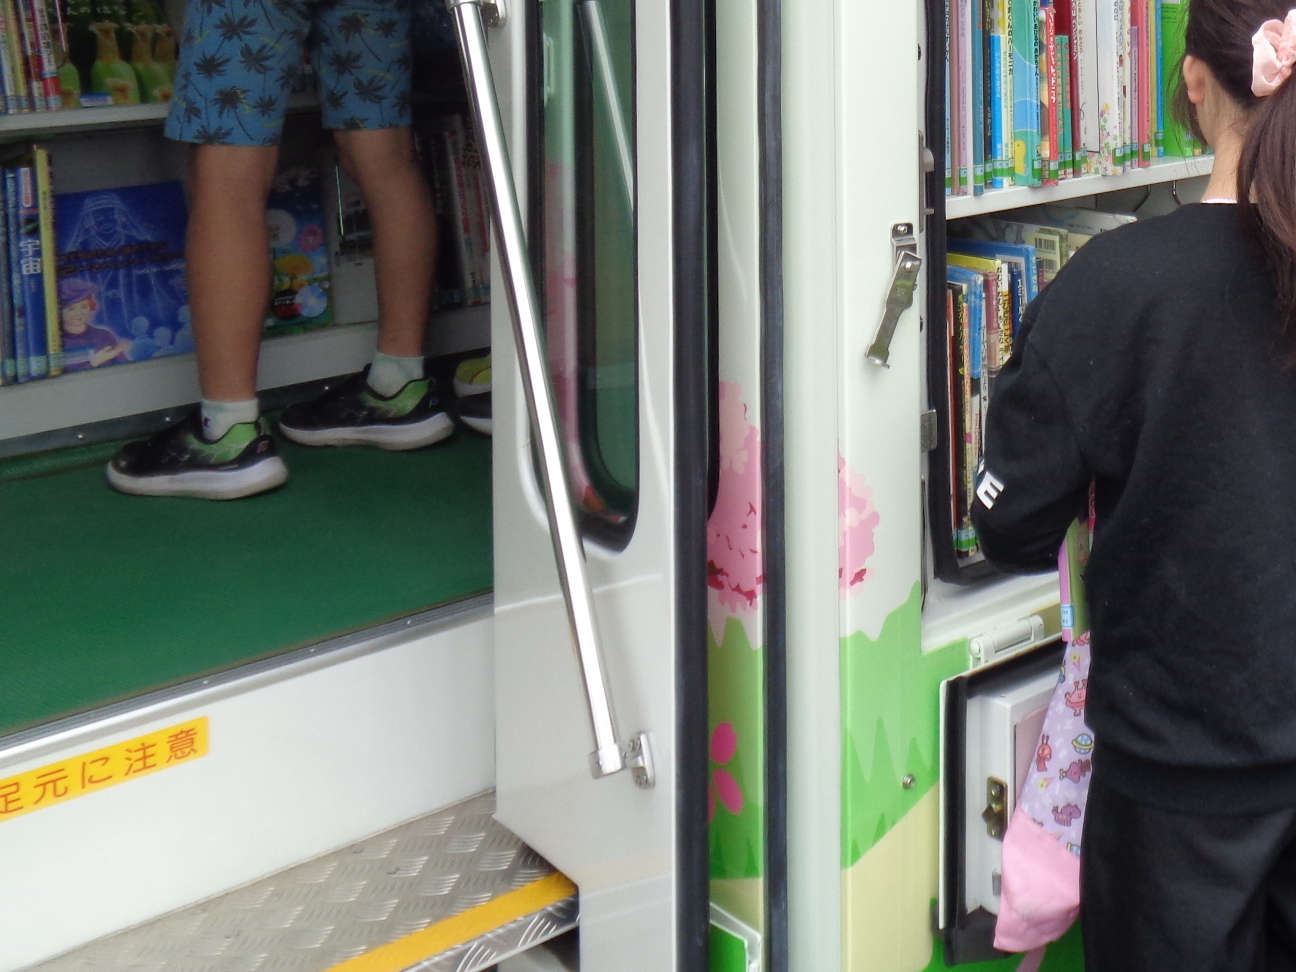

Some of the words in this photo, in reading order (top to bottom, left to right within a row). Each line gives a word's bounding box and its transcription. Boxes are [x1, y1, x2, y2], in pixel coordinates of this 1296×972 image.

[19, 238, 42, 275] 宇宙
[0, 727, 200, 816] 足元に注意
